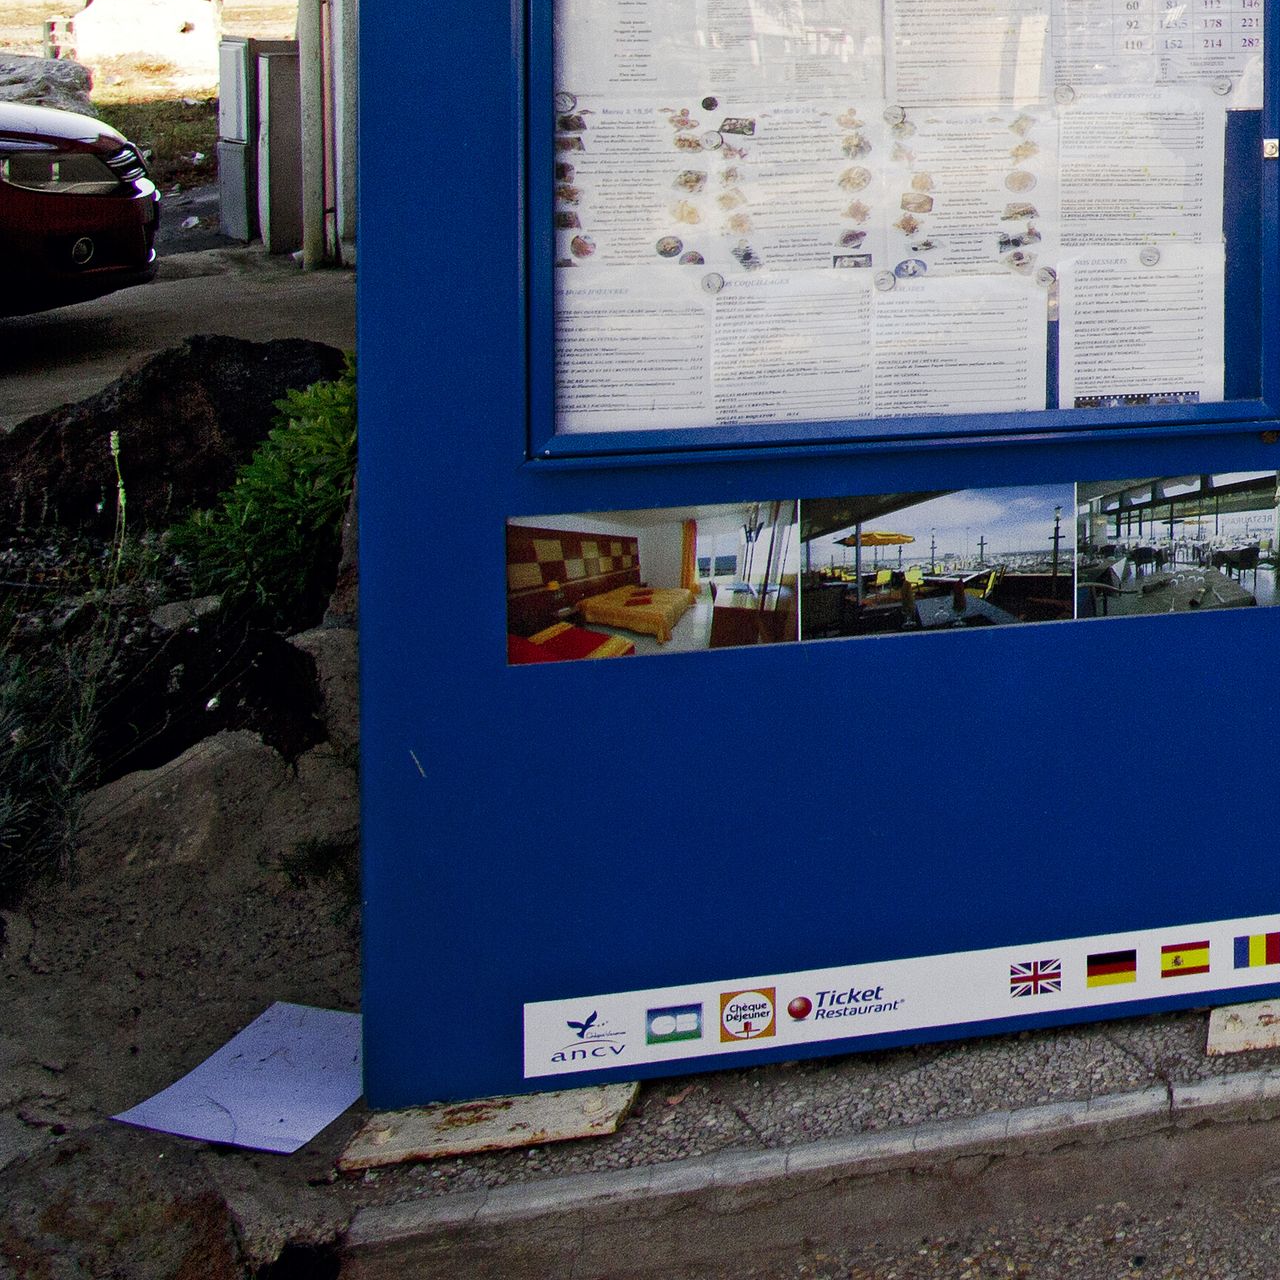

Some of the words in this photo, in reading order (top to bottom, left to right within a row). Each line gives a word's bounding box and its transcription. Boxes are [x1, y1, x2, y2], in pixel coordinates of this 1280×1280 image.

[1126, 1, 1139, 11] 60
[1242, 0, 1260, 9] 146
[1126, 20, 1140, 30] 92
[1203, 19, 1222, 28] 178
[1241, 18, 1259, 28] 221
[1125, 40, 1143, 50] 110
[1164, 40, 1183, 49] 152
[1203, 39, 1222, 48] 214
[815, 986, 884, 1008] Ticket
[729, 1001, 767, 1016] Chèque
[726, 1010, 771, 1023] Déjeuner
[551, 1044, 626, 1063] ancv
